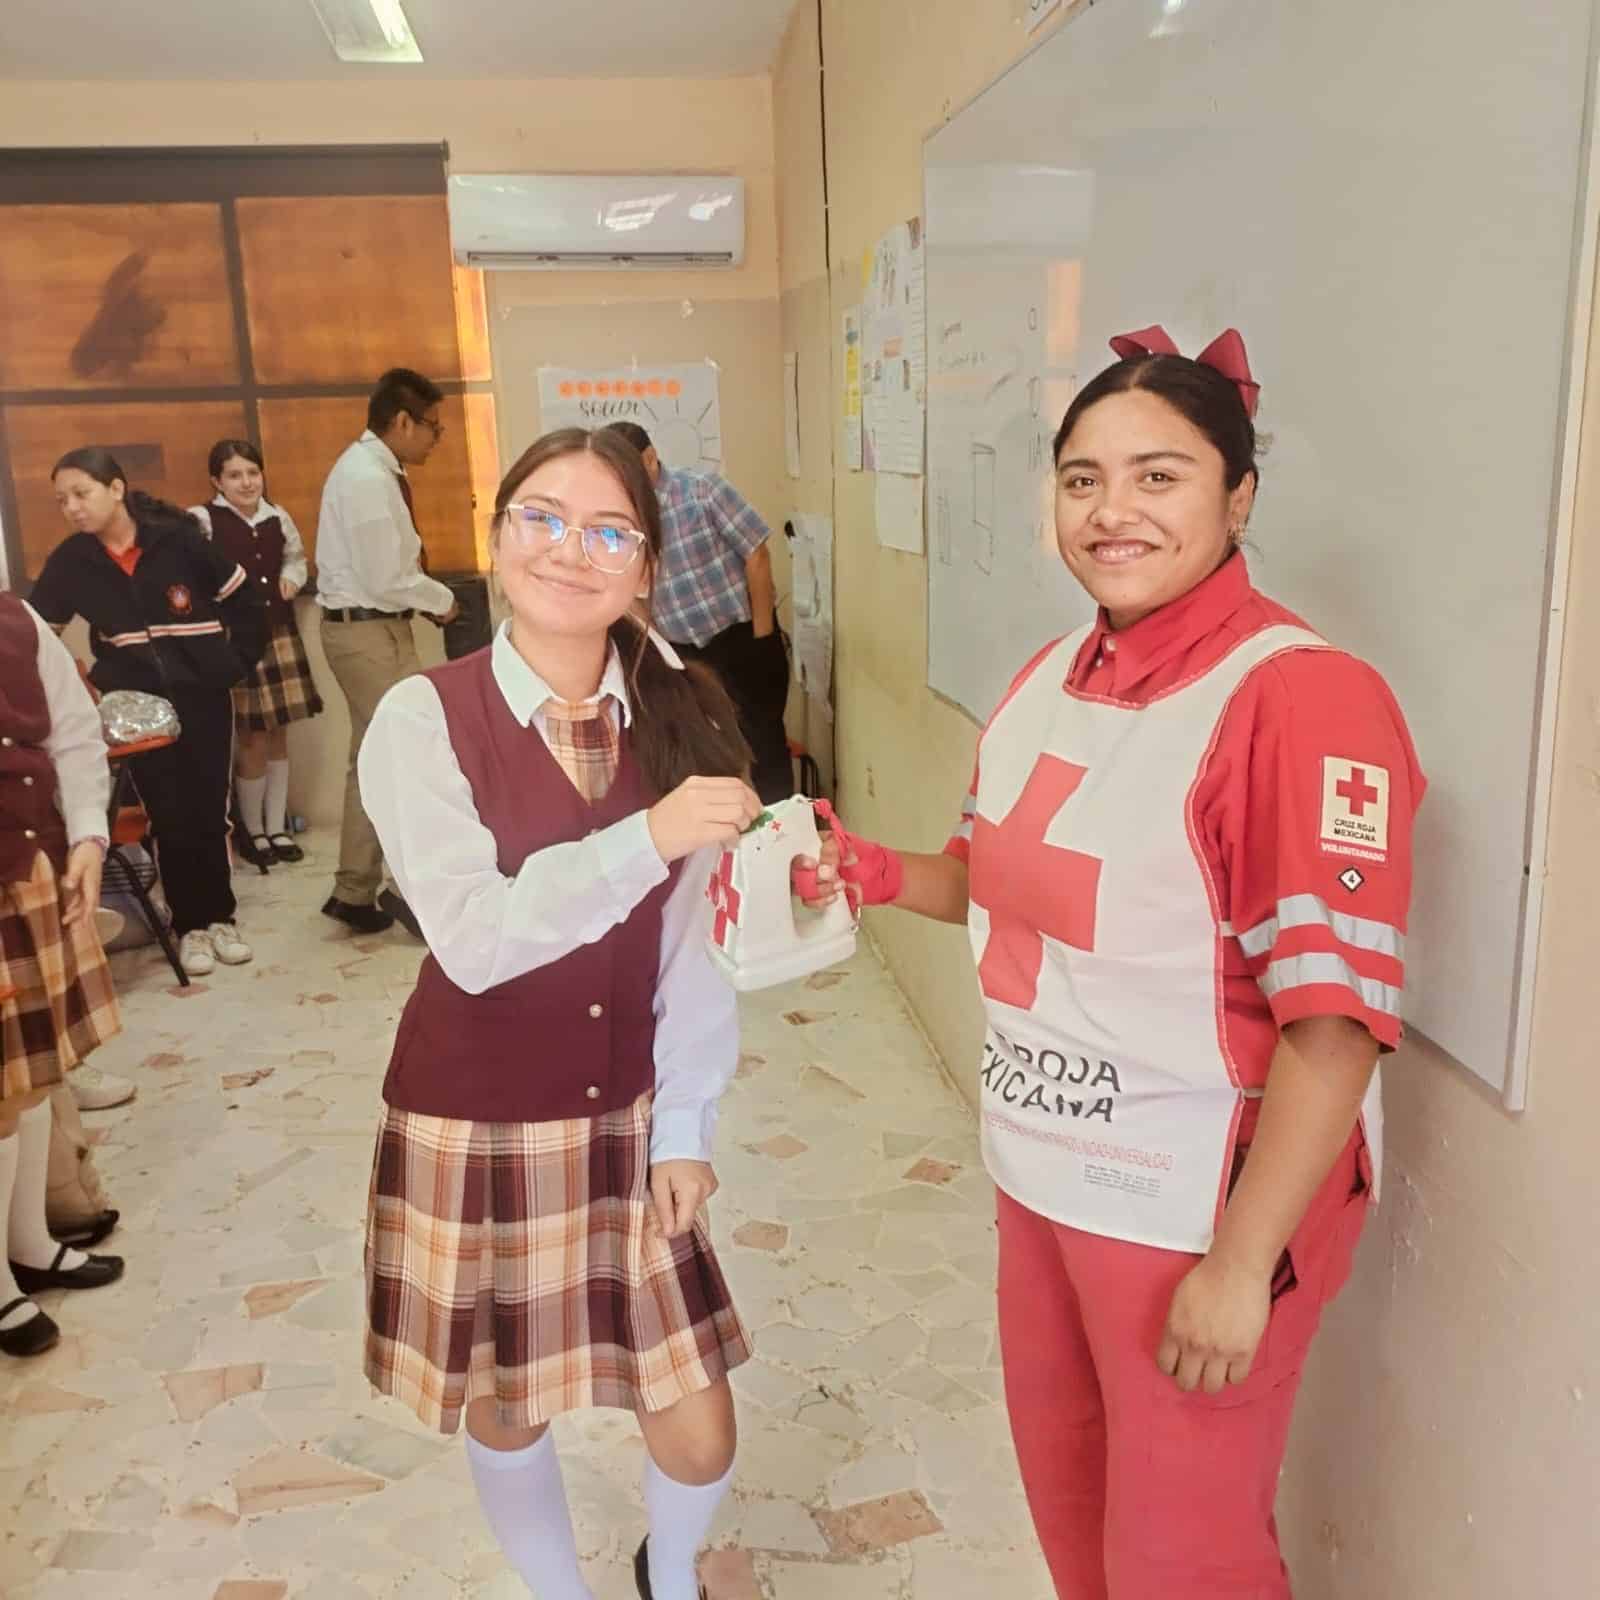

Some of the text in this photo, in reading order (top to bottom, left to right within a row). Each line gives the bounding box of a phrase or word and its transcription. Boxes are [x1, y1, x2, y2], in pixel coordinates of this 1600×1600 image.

[1334, 818, 1377, 833] CRUZ ROJA
[1333, 827, 1377, 842] MEXICANA
[1347, 873, 1356, 884] 4
[980, 1043, 1114, 1124] XICANA
